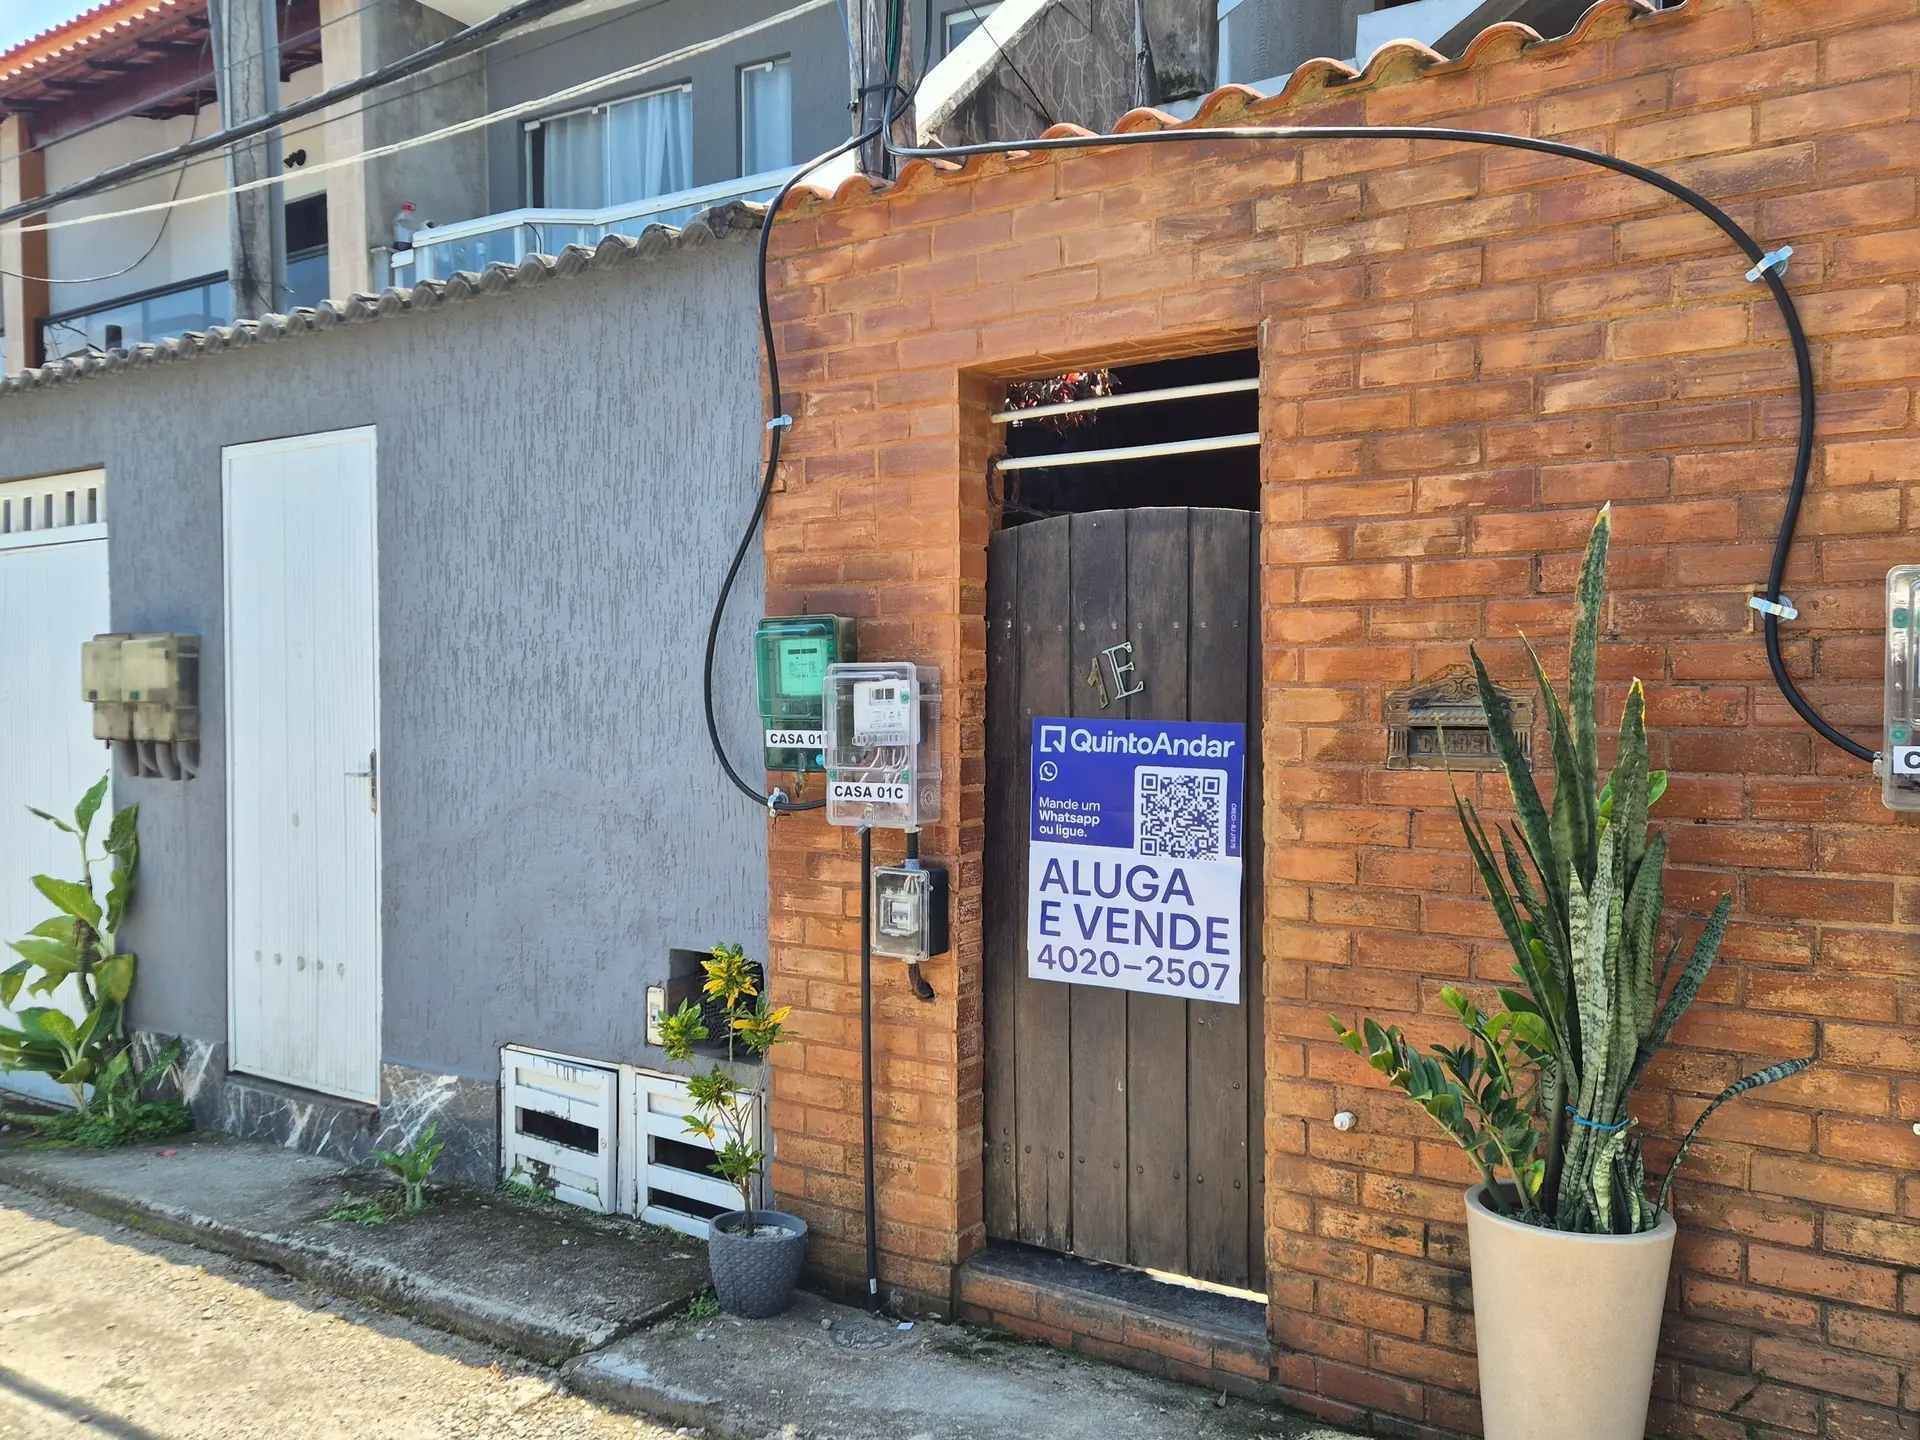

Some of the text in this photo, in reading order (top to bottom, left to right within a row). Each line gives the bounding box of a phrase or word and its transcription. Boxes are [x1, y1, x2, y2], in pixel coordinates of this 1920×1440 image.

[770, 733, 804, 745] CASA
[1070, 728, 1235, 758] QuintoAndar
[834, 785, 904, 799] CASA 01C
[1039, 797, 1100, 811] Mande um
[1039, 810, 1100, 827] Whatsapp
[1039, 824, 1087, 838] ou ligue.
[1039, 857, 1195, 906] ALUGA
[1039, 900, 1230, 955] E VENDE
